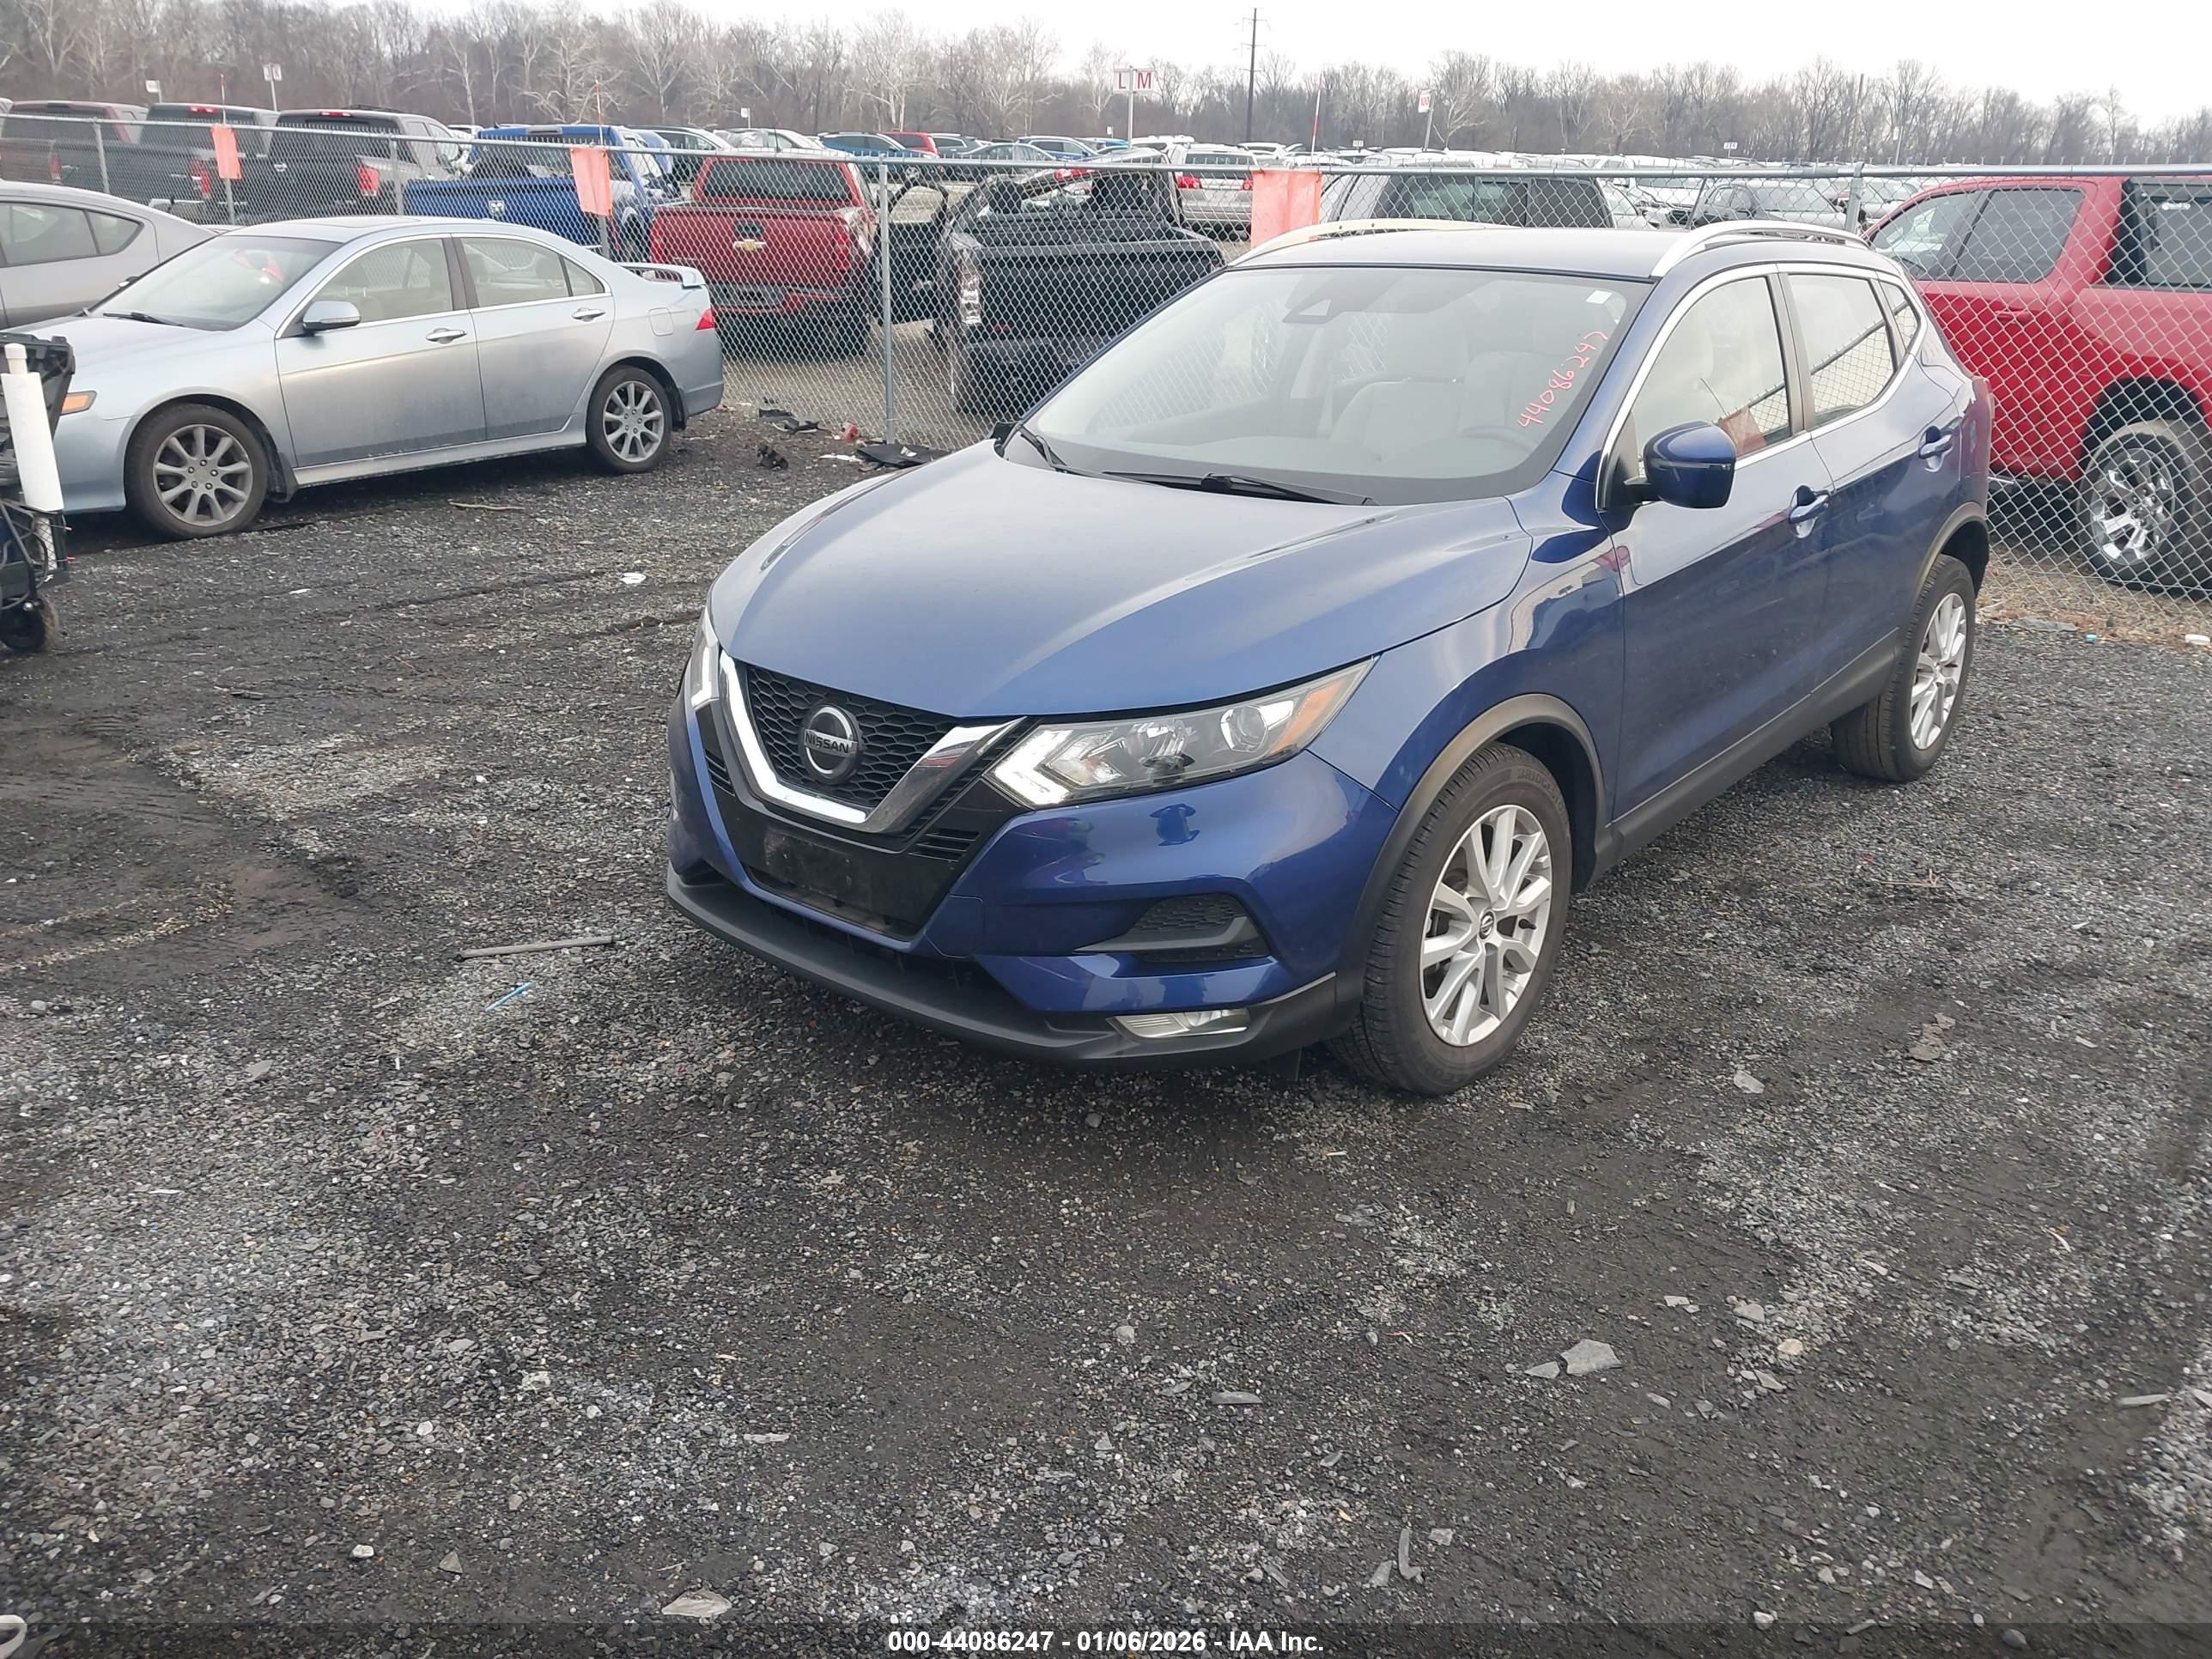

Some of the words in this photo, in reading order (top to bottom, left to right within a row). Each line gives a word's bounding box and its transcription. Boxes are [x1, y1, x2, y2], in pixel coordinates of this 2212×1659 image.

[1118, 72, 1127, 89] L
[1138, 72, 1152, 89] M
[805, 732, 849, 754] NISSAN
